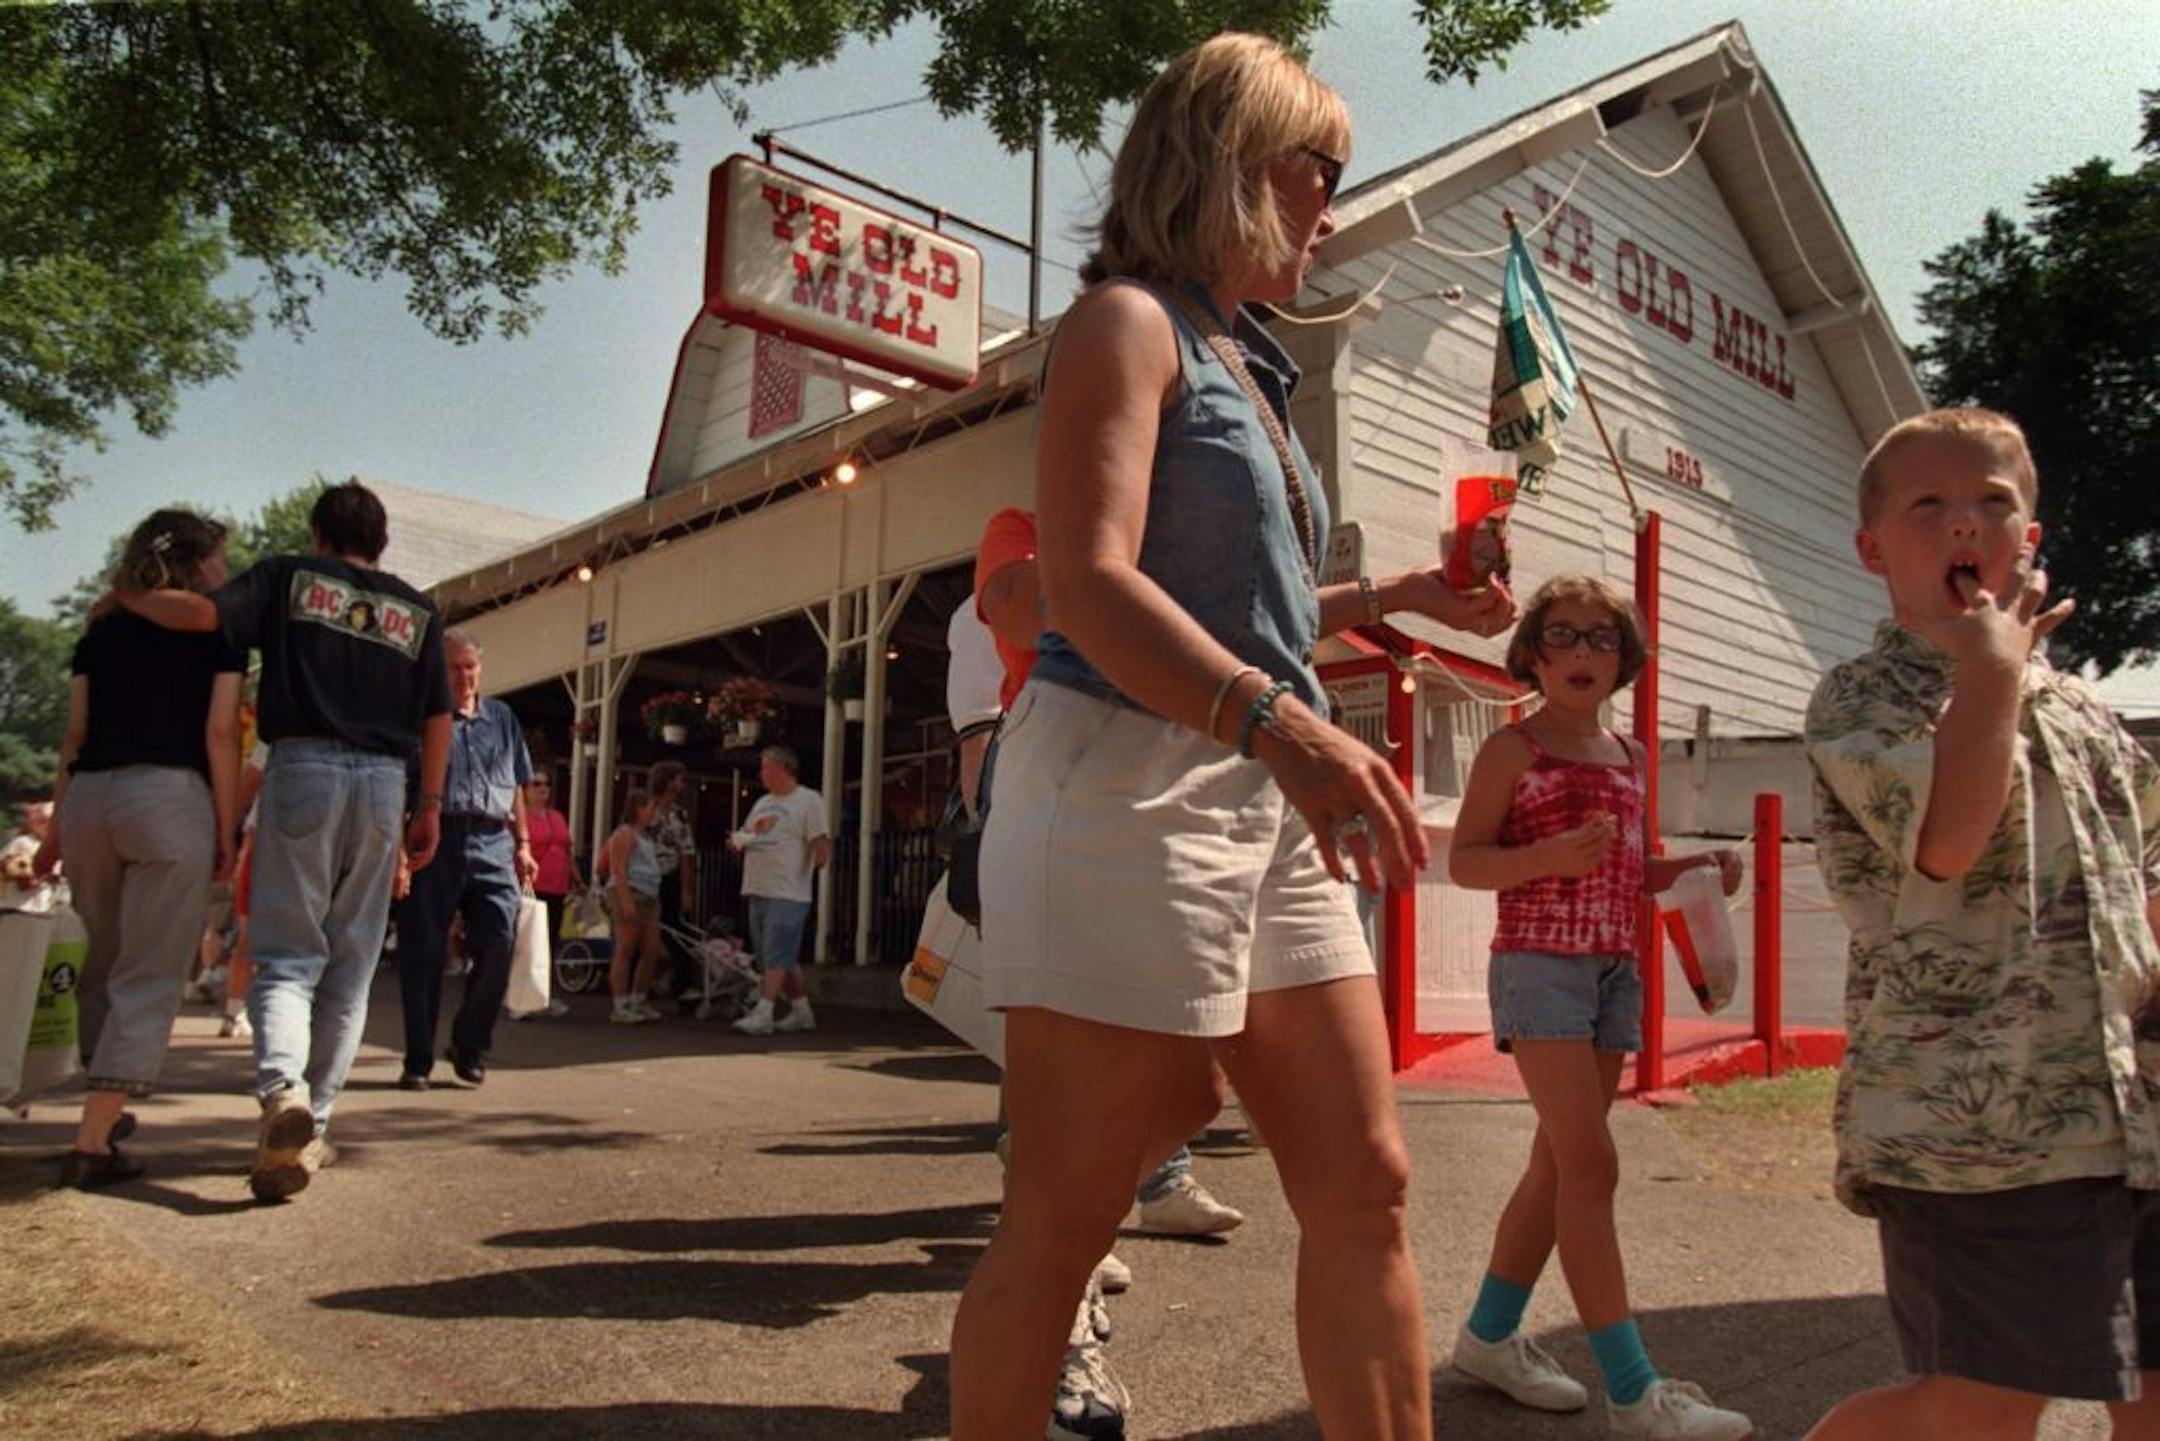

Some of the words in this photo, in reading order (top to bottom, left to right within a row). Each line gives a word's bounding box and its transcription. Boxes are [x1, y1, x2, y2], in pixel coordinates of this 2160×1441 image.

[761, 183, 840, 257] YE
[863, 223, 961, 300] OLD
[792, 251, 938, 348] MILL
[1533, 182, 1594, 288] YE
[1617, 237, 1693, 344] OLD
[1711, 292, 1796, 401] MILL
